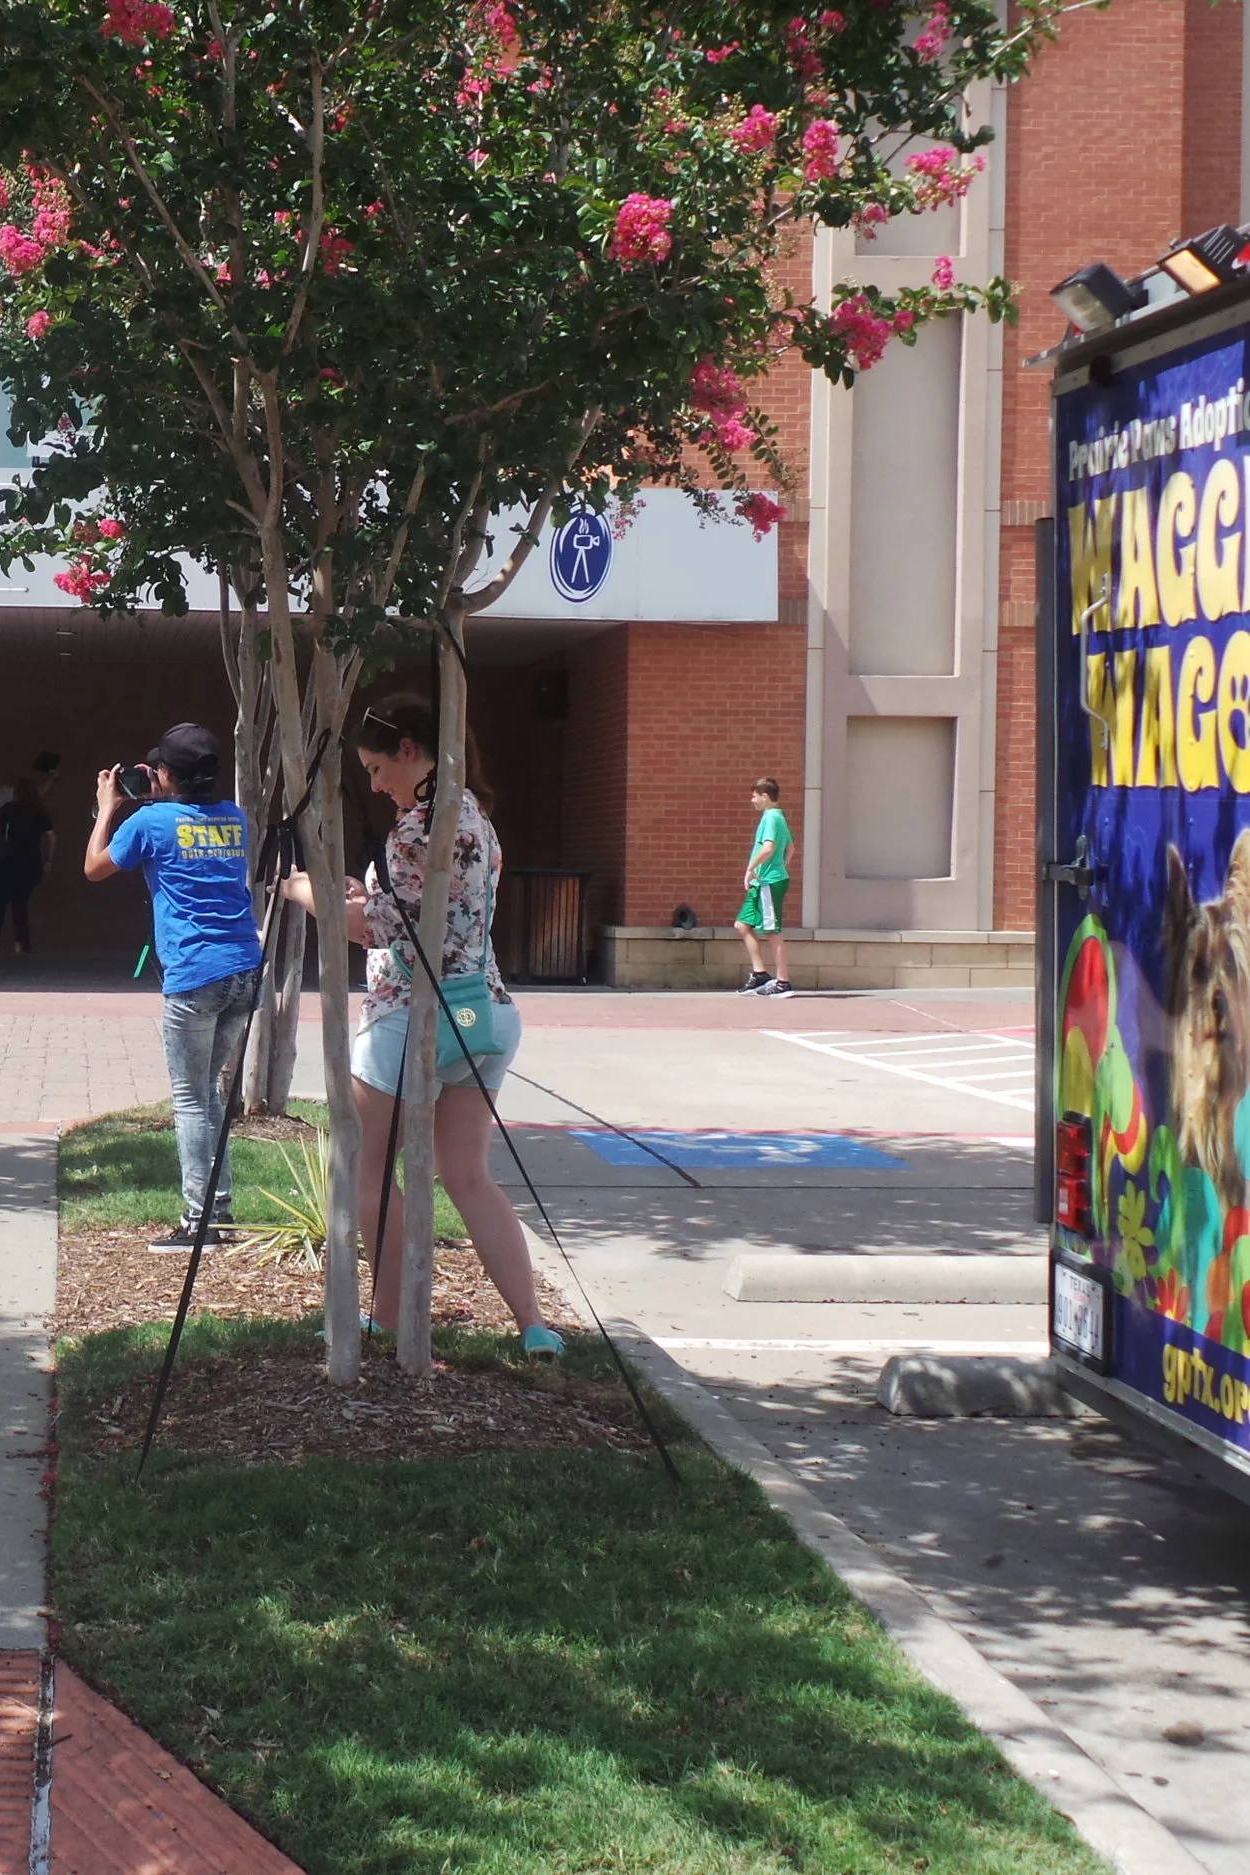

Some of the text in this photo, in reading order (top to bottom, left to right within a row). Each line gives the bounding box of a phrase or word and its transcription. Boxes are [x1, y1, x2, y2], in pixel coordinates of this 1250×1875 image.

[1069, 420, 1128, 481] Prairie
[1129, 418, 1176, 462] Paws
[176, 824, 242, 848] STAFF
[1070, 1275, 1091, 1298] TEXAS
[1162, 1343, 1250, 1424] gptx.or
